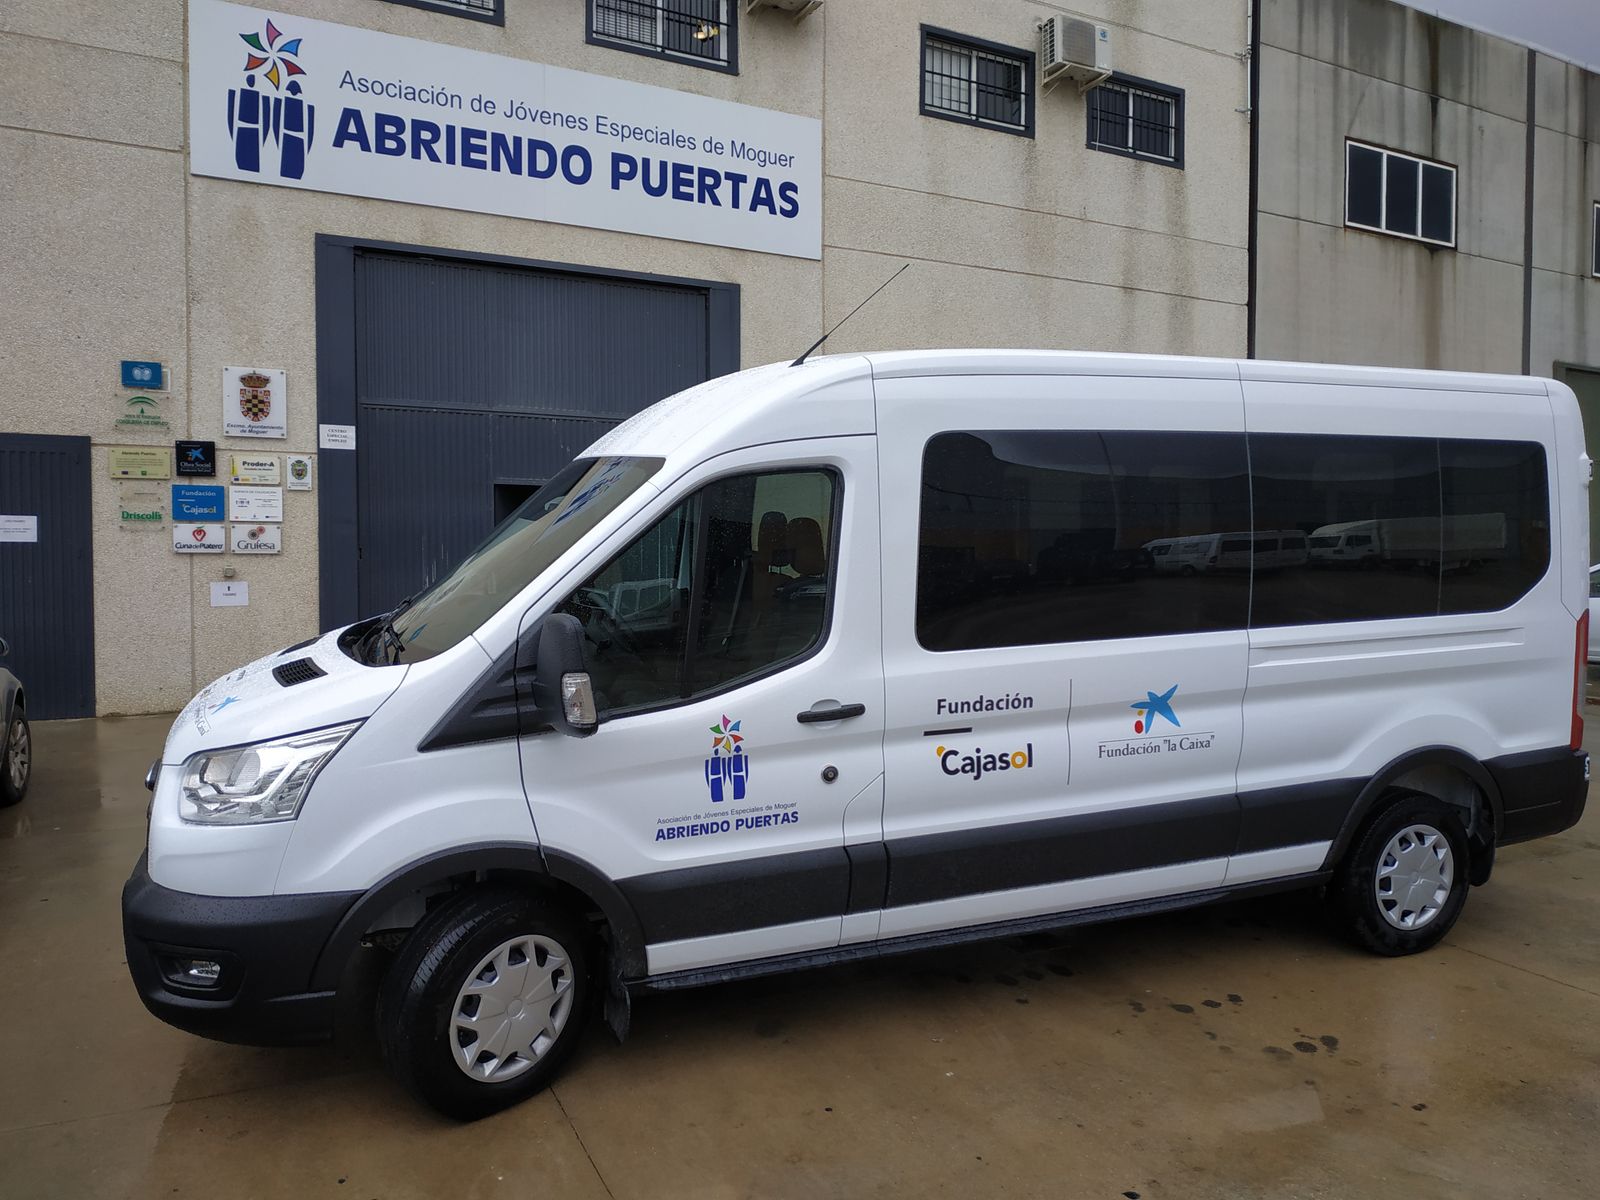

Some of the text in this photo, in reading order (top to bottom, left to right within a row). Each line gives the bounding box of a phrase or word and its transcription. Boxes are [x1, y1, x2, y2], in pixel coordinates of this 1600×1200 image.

[338, 69, 796, 169] Asociación de Jóvenes Especiales de Moguer
[332, 107, 800, 219] ABRIENDO PUERTAS
[182, 503, 217, 515] Cajasol
[237, 539, 276, 550] Grufesa
[936, 693, 1034, 715] Fundación
[1098, 735, 1216, 758] Fundación "la Caixa"
[937, 742, 1034, 780] Cajasol
[656, 814, 692, 825] Asociación
[693, 812, 702, 820] de
[702, 809, 729, 819] Jóvenes
[730, 806, 764, 816] Especiales
[774, 801, 797, 811] Moguer
[655, 811, 799, 841] ABRIENDO PUERTAS
